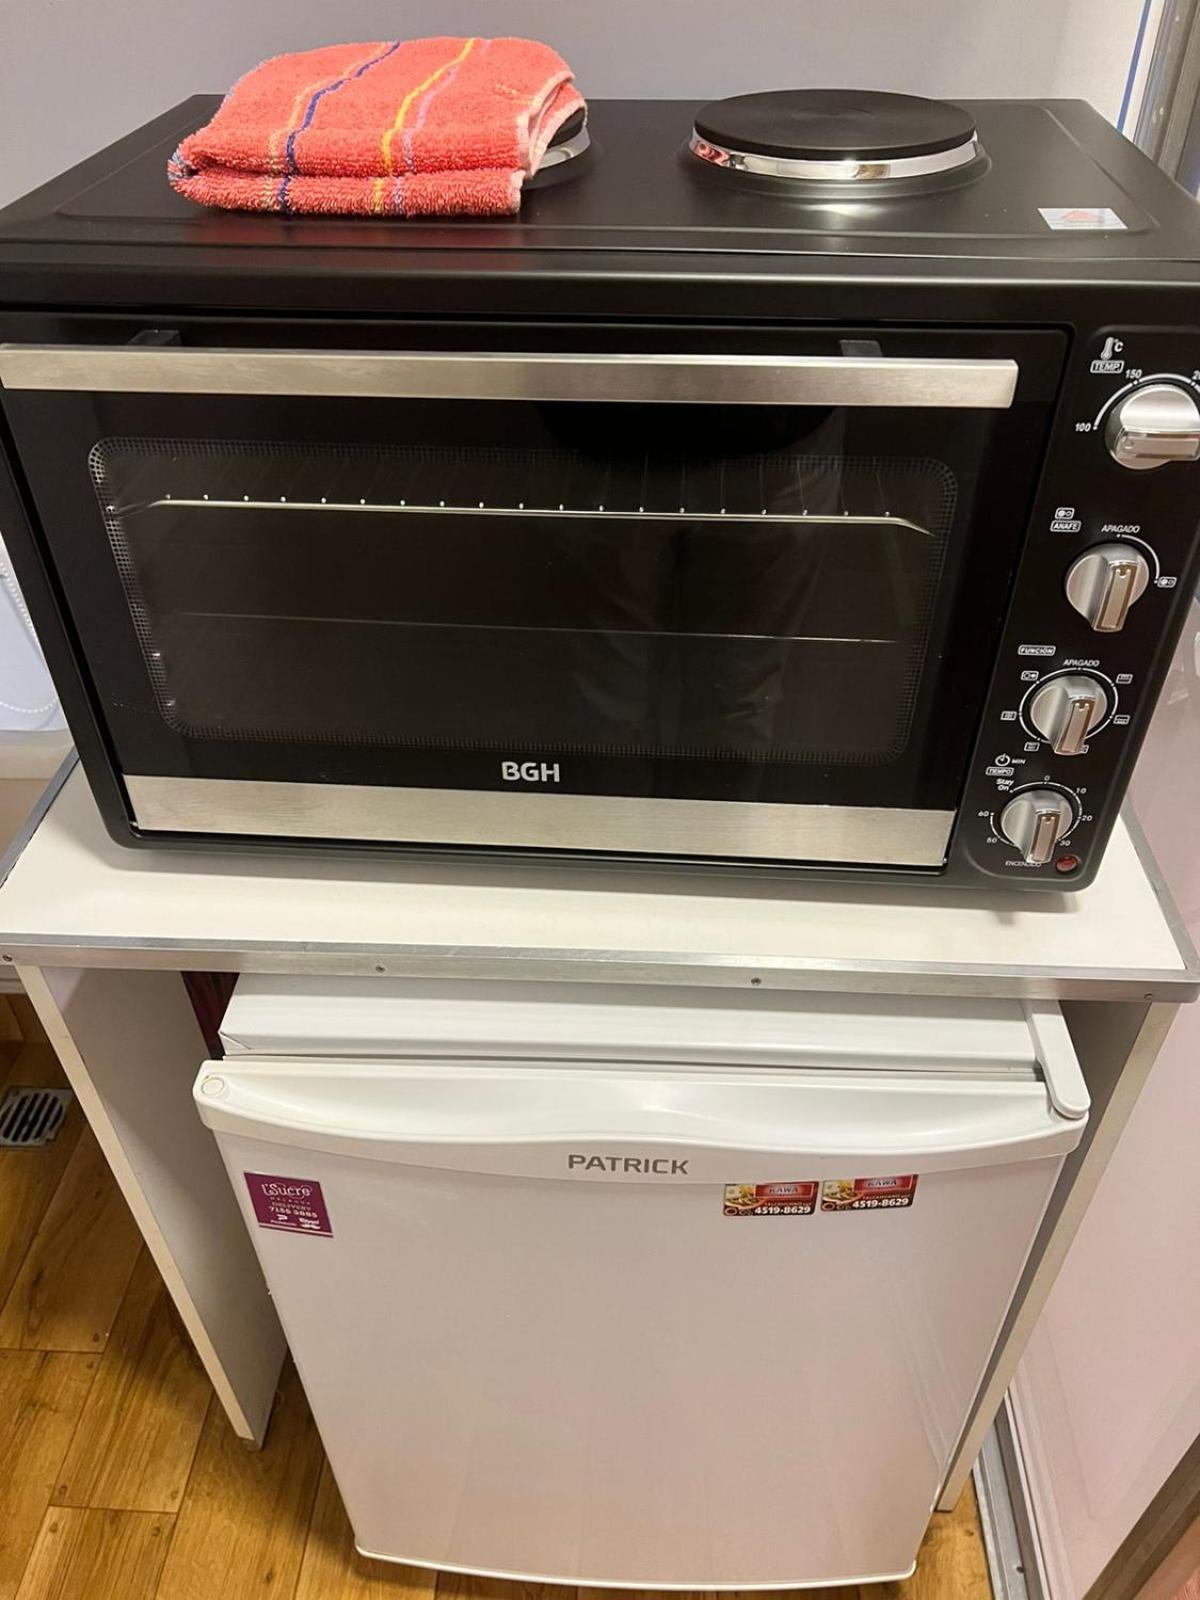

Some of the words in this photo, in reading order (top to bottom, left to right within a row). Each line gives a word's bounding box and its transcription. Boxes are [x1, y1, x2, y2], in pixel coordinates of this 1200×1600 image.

[1125, 369, 1142, 379] 150
[1075, 422, 1091, 432] 100
[1053, 522, 1078, 530] ANAFE
[1101, 524, 1140, 533] APAGADO
[501, 761, 560, 782] BGH
[996, 778, 1014, 787] Stay
[568, 1154, 689, 1175] PATRICK
